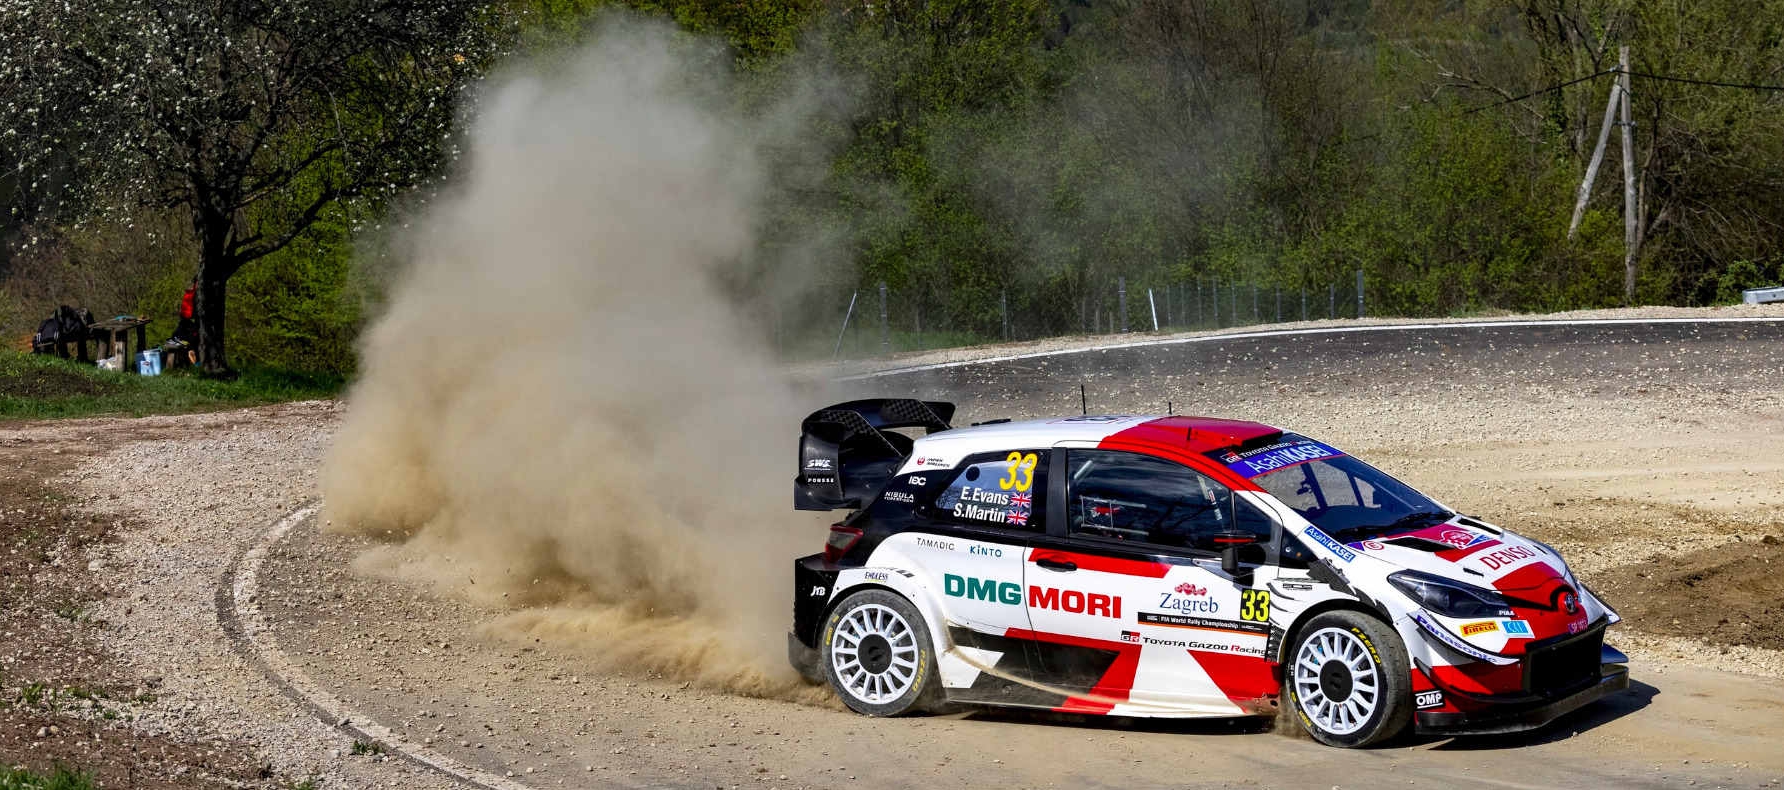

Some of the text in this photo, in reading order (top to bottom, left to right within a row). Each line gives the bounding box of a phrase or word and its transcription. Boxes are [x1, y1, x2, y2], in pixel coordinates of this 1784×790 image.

[999, 451, 1038, 493] 33
[961, 486, 1009, 505] E.Evans
[953, 502, 1006, 523] S.Martin
[1479, 545, 1536, 571] DENSO
[944, 573, 1121, 619] DMG MORI
[1159, 592, 1220, 615] Zagreb
[1241, 589, 1270, 622] 33
[1142, 636, 1187, 648] TOYOTA
[1188, 641, 1229, 651] GAZOO
[1416, 614, 1499, 664] Panasonic
[1416, 694, 1443, 707] OMP
